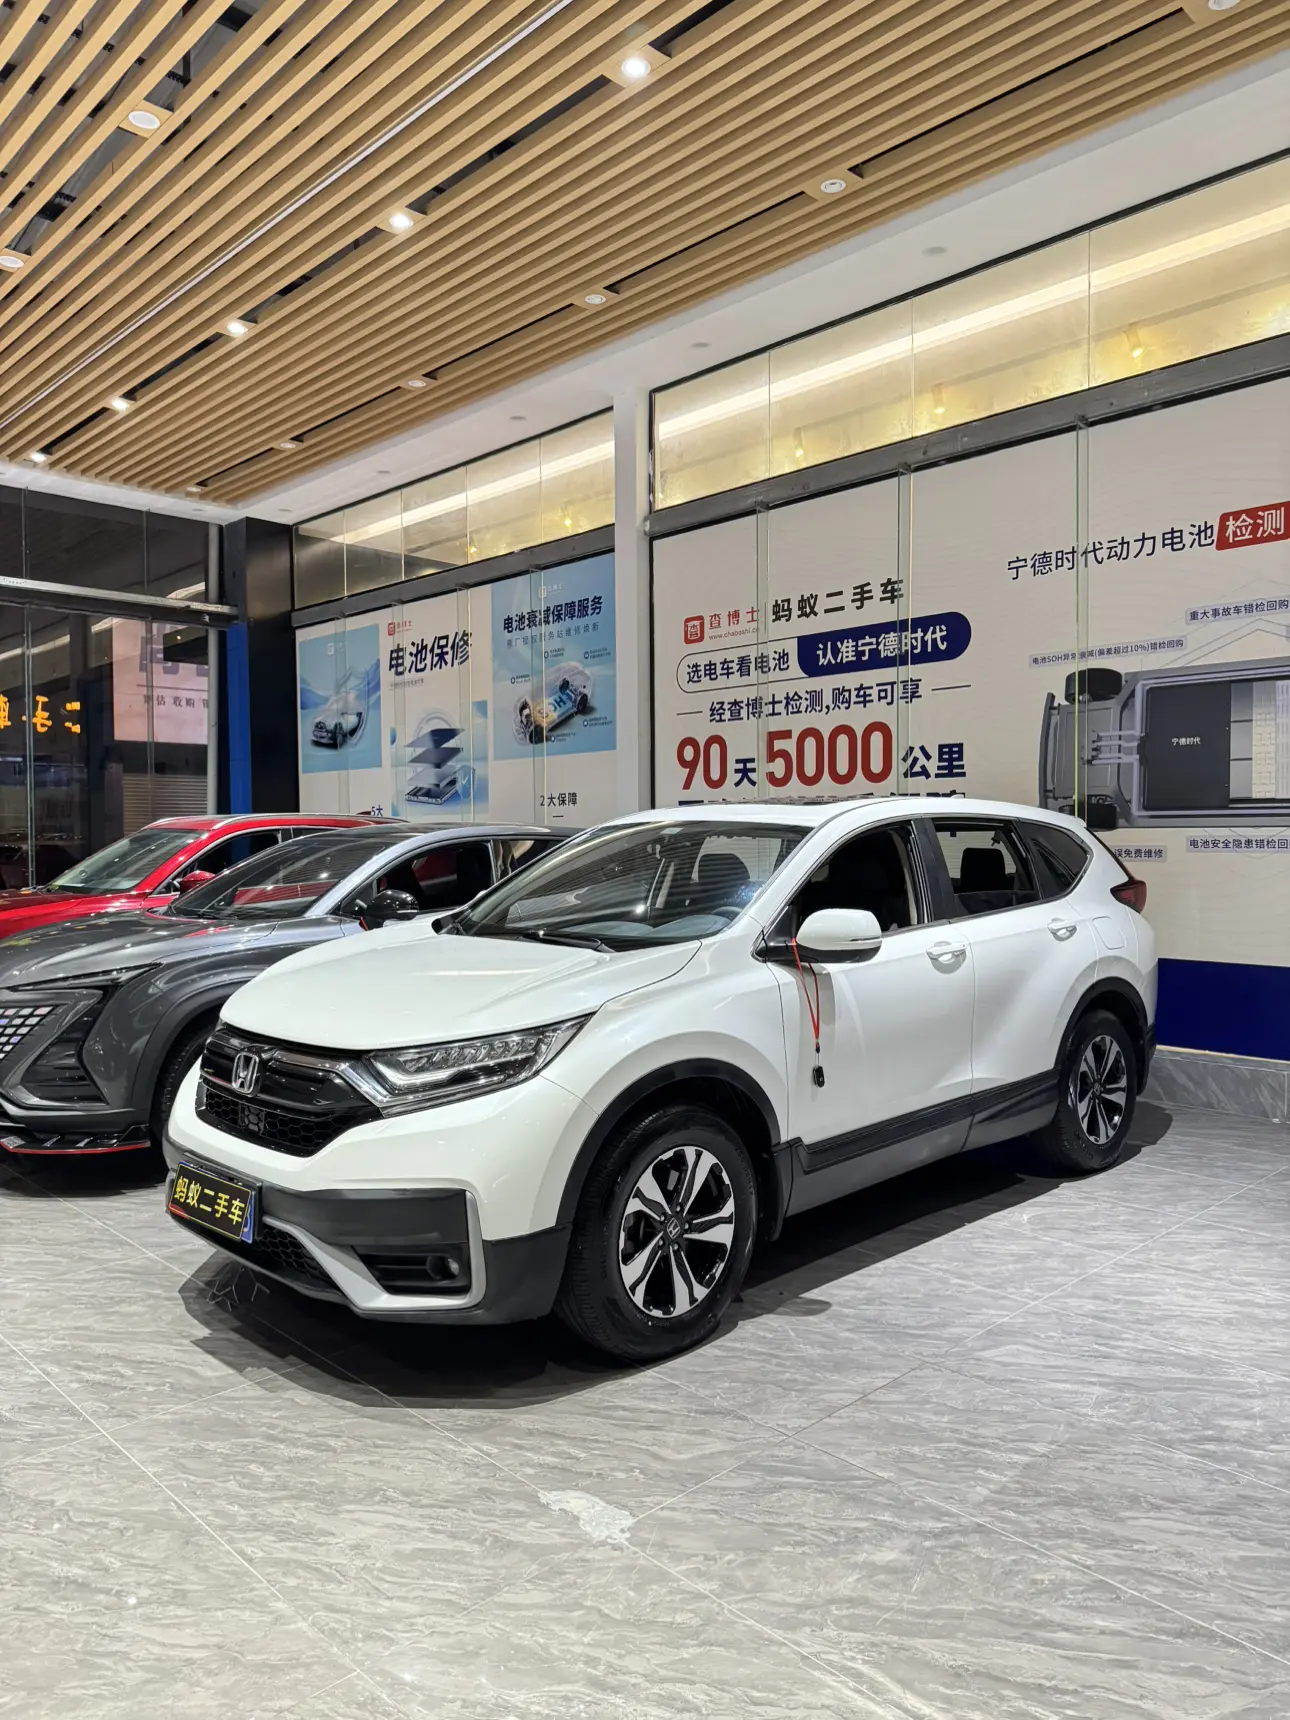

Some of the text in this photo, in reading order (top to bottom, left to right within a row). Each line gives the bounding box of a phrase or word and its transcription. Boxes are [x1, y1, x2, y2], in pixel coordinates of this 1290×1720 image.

[1007, 506, 1285, 581] 宁德时代动力电池 检测
[503, 595, 603, 634] 电池衰减保障服务
[709, 606, 760, 630] 查博士
[772, 577, 904, 623] 蚂蚁二手车
[1189, 598, 1289, 621] 重大事故车错检回购
[388, 629, 473, 676] 电池保修
[686, 625, 947, 684] 选电车看电池 认准宁德时代
[1171, 736, 1201, 746] 宁德时代
[540, 792, 578, 807] 2大保障
[174, 1176, 245, 1225] 蚂蚁二手车
